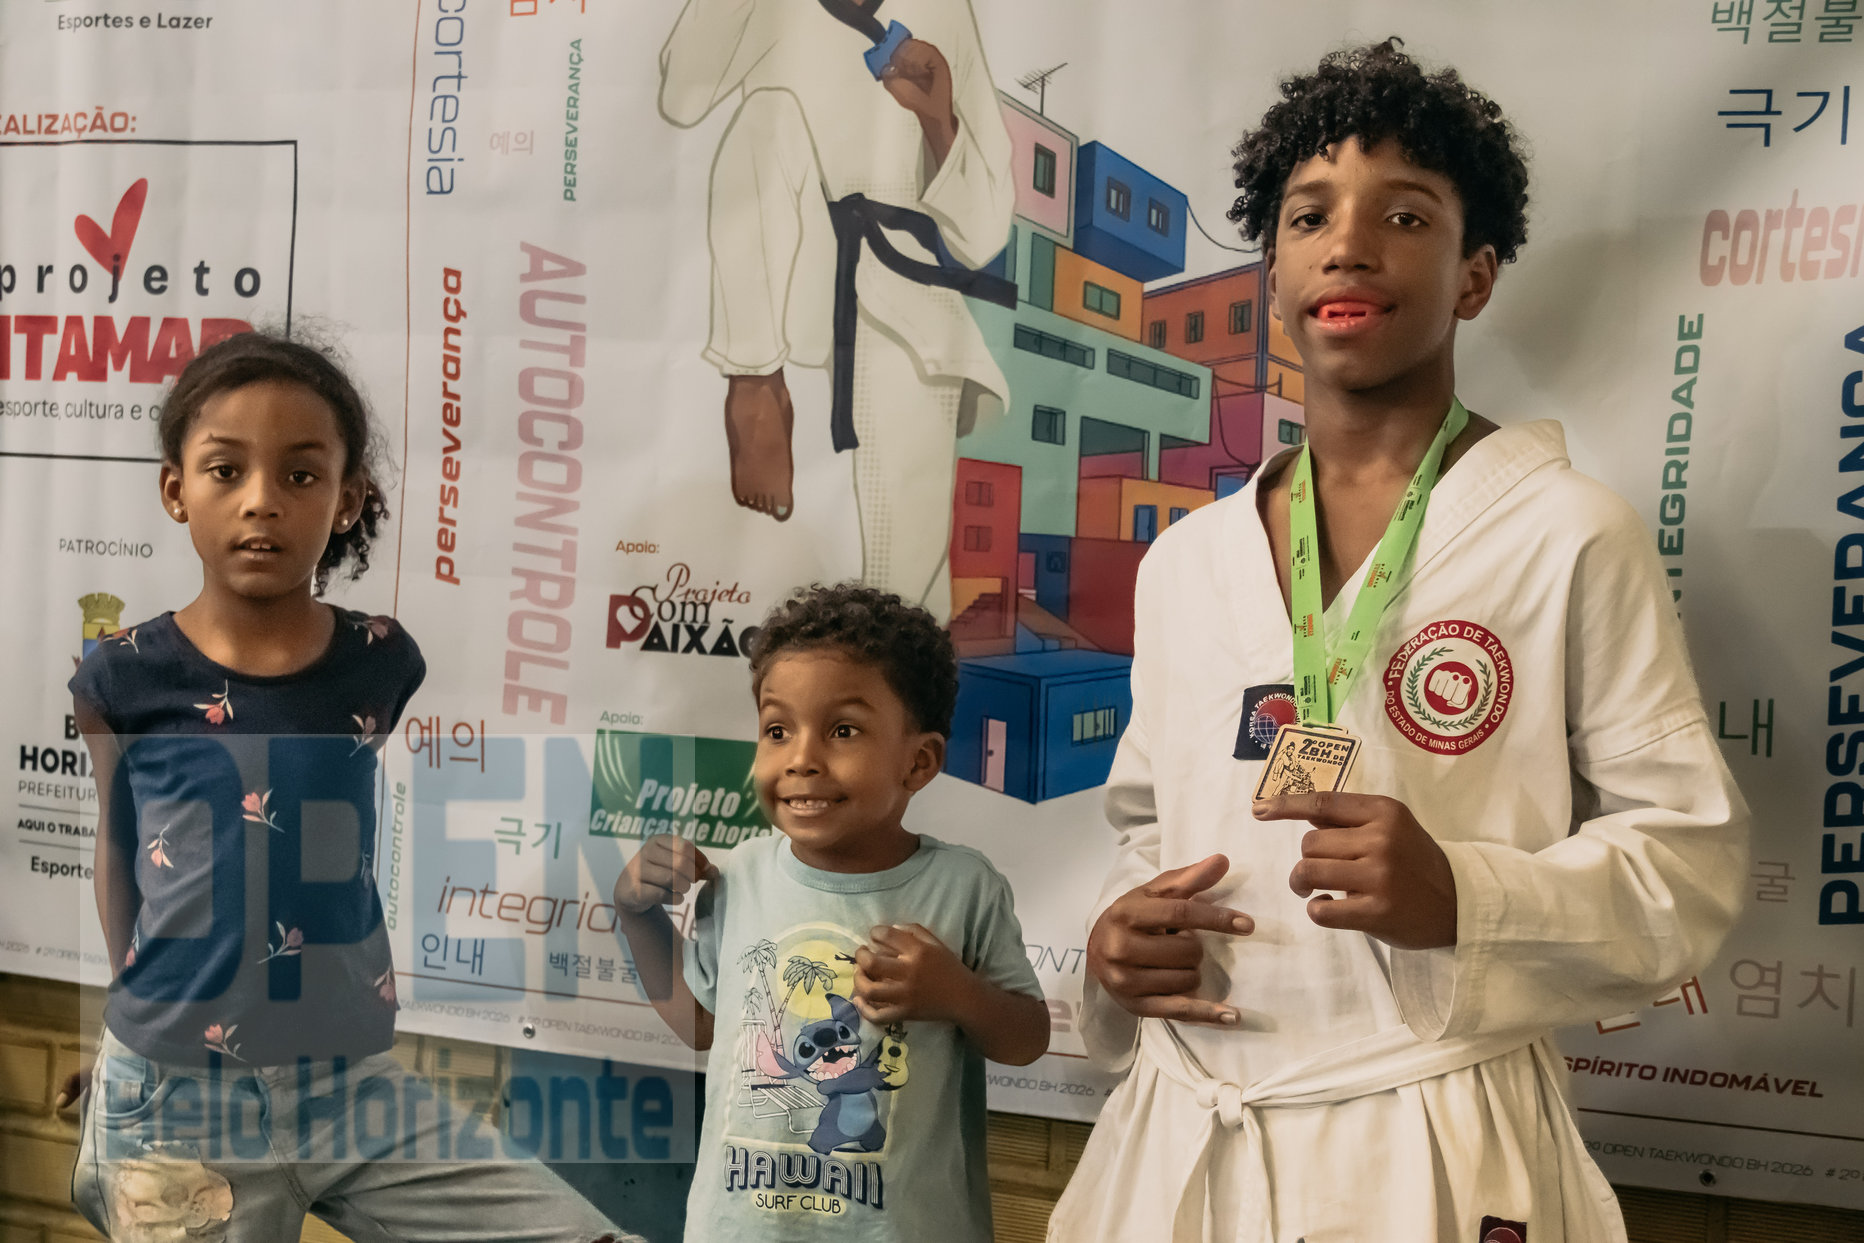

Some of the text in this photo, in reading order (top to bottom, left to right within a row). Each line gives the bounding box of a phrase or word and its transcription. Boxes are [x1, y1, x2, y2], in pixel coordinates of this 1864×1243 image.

[58, 11, 213, 31] Esportes e Lazer
[1711, 0, 1863, 45] 백절불
[0, 105, 137, 139] ALIZAÇÃO:
[563, 38, 584, 202] PERSEVERANÇA
[1717, 85, 1850, 148] 극기
[489, 130, 534, 156] 예의
[1700, 188, 1864, 287] cortesi
[0, 252, 261, 303] projeto
[65, 399, 124, 420] cultura
[130, 404, 142, 420] e
[435, 267, 468, 585] perseverança
[502, 241, 587, 725] AUTOCONTROLE
[59, 537, 153, 558] PATROCÍNIO
[615, 540, 660, 555] Apoio:
[629, 584, 711, 625] Com
[666, 562, 752, 608] Projeto
[1388, 623, 1459, 679] FEDERAÇÃO
[1463, 626, 1484, 643] DE
[600, 710, 643, 726] Apoio:
[1386, 690, 1485, 751] DO ESTADO DE MINAS GERAIS
[1718, 698, 1775, 758] 내
[405, 716, 485, 773] 예의
[1297, 754, 1343, 767] TAEKWONDO
[1308, 747, 1345, 762] BH DE
[1318, 741, 1350, 752] OPEN
[18, 780, 96, 801] PREFEITUR
[635, 779, 741, 819] Projeto
[18, 818, 96, 838] AQUI O TRABA
[494, 816, 562, 859] 극기
[682, 818, 708, 843] de
[711, 819, 772, 845] hort
[31, 855, 94, 879] Esporte
[387, 782, 407, 931] autocontrole
[1750, 861, 1796, 903] 굴
[421, 933, 485, 976] 인내
[1729, 958, 1857, 1029] 염치
[542, 1018, 571, 1032] OPEN
[987, 1074, 1038, 1091] WONDO
[1039, 1080, 1059, 1092] BH
[1060, 1082, 1095, 1097] 2026
[1563, 1055, 1824, 1098] SPÍRITO INDOMÁVEL
[724, 1145, 884, 1210] HAWAII
[1602, 1143, 1645, 1159] OPEN
[1649, 1147, 1745, 1170] TAEKWONDO
[1746, 1158, 1768, 1172] BH
[1770, 1160, 1814, 1177] 2026
[755, 1193, 842, 1214] SURF CLUB
